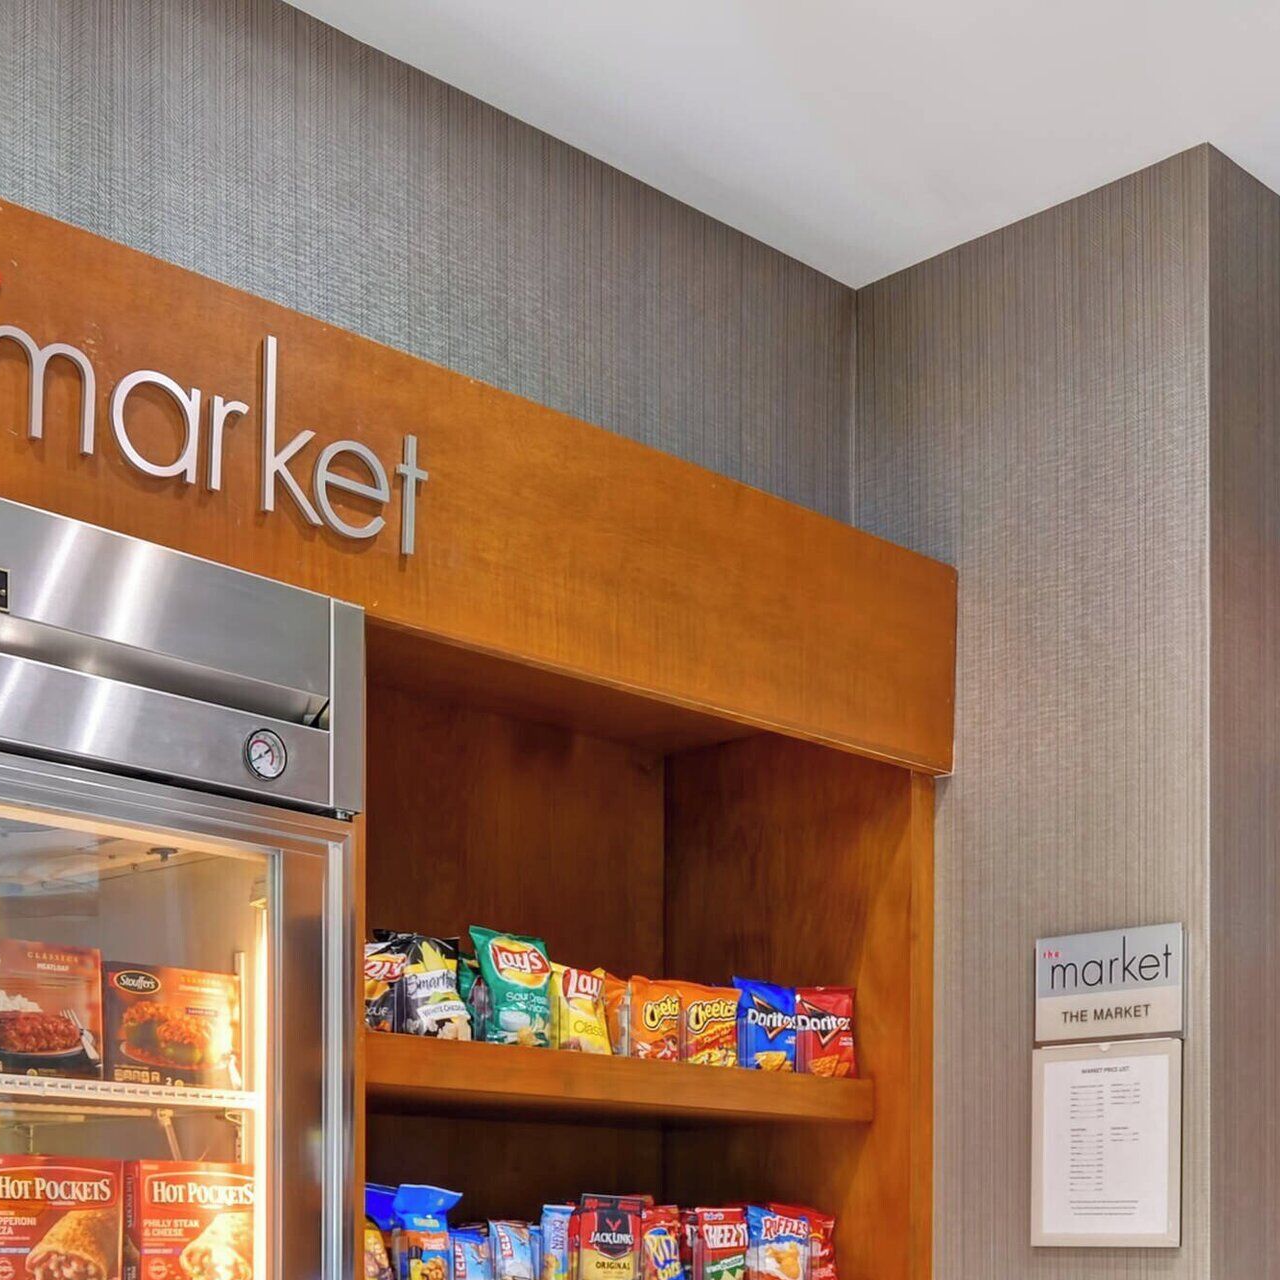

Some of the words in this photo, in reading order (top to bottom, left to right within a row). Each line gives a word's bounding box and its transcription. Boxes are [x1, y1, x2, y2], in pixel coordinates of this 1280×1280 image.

[496, 944, 543, 971] Lay's
[1043, 951, 1061, 959] the
[1051, 936, 1172, 990] market
[119, 974, 156, 990] Stouffer's
[506, 991, 529, 1001] Sour
[796, 1013, 852, 1031] Doritos
[1062, 1010, 1089, 1024] THE
[1093, 1004, 1151, 1022] MARKET
[34, 1177, 112, 1203] POCKETS
[152, 1180, 187, 1204] HOT
[187, 1181, 255, 1206] POCKETS
[143, 1219, 173, 1228] PHILLY
[174, 1219, 200, 1228] STEAK
[761, 1215, 810, 1240] RUFFLES
[595, 1261, 631, 1271] ORIGINAL
